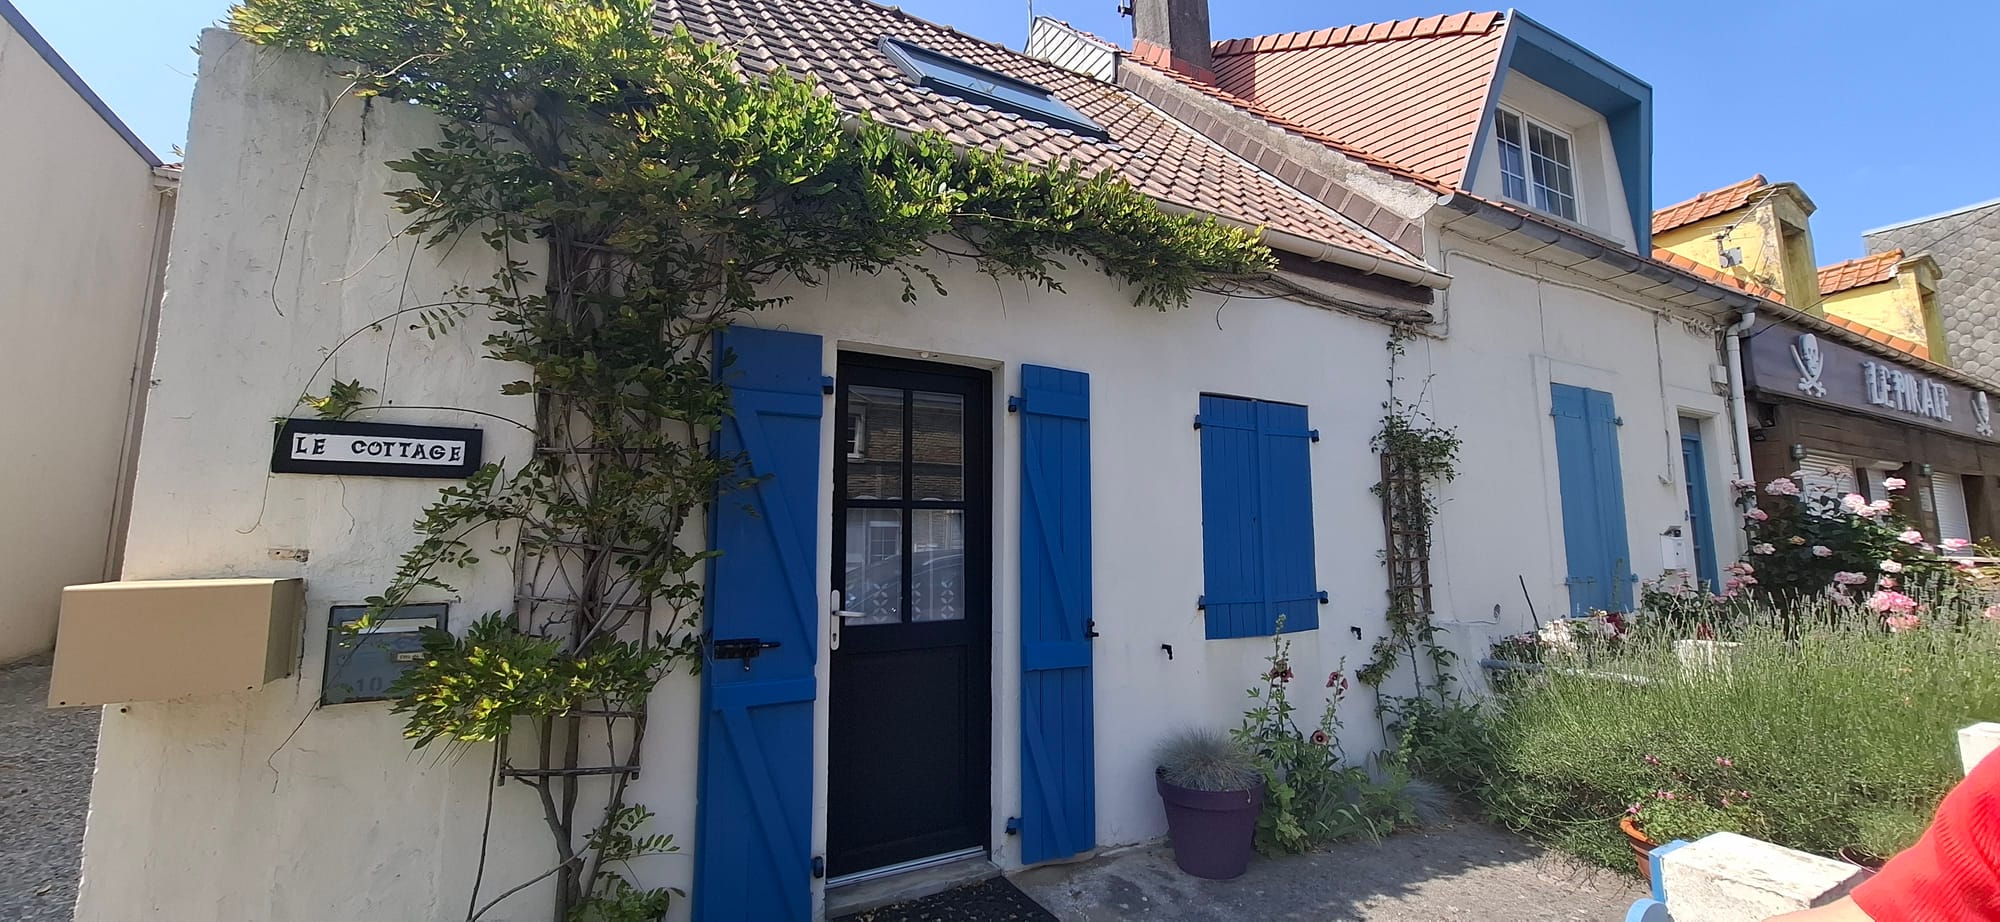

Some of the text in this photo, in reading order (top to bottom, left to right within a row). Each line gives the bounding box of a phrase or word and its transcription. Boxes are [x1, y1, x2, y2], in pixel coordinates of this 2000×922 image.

[1863, 361, 1952, 422] LE PIRATE
[295, 436, 462, 462] LE COTTAGE
